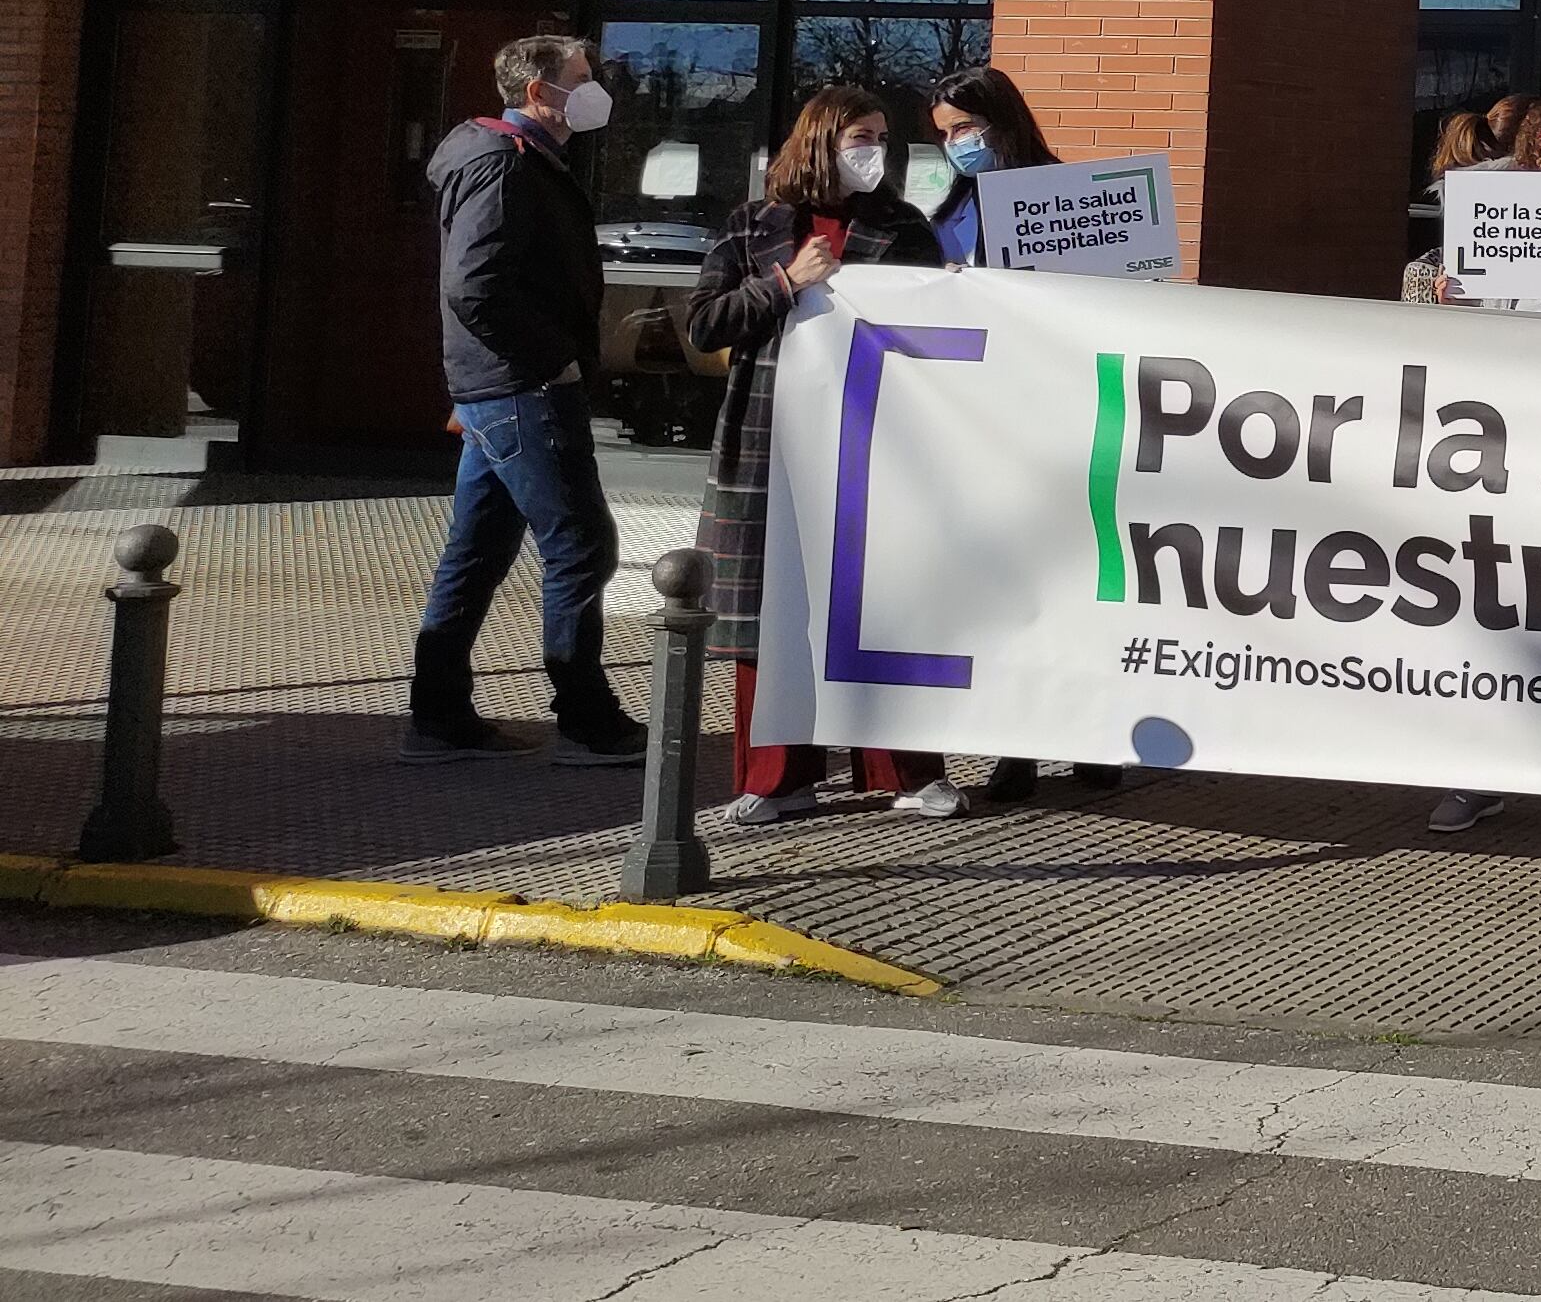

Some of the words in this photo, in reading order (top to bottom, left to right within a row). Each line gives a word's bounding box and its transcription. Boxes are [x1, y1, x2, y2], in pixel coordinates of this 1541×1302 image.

[1014, 201, 1050, 217] Por
[1055, 196, 1074, 212] la
[1079, 187, 1137, 209] salud
[1475, 203, 1508, 219] Por
[1514, 204, 1530, 220] la
[1016, 220, 1044, 236] de
[1050, 206, 1143, 232] nuestros
[1474, 222, 1496, 238] de
[1017, 228, 1128, 255] hospitales
[1127, 257, 1173, 272] SATSE
[1136, 356, 1363, 483] Por
[1393, 365, 1509, 494] la
